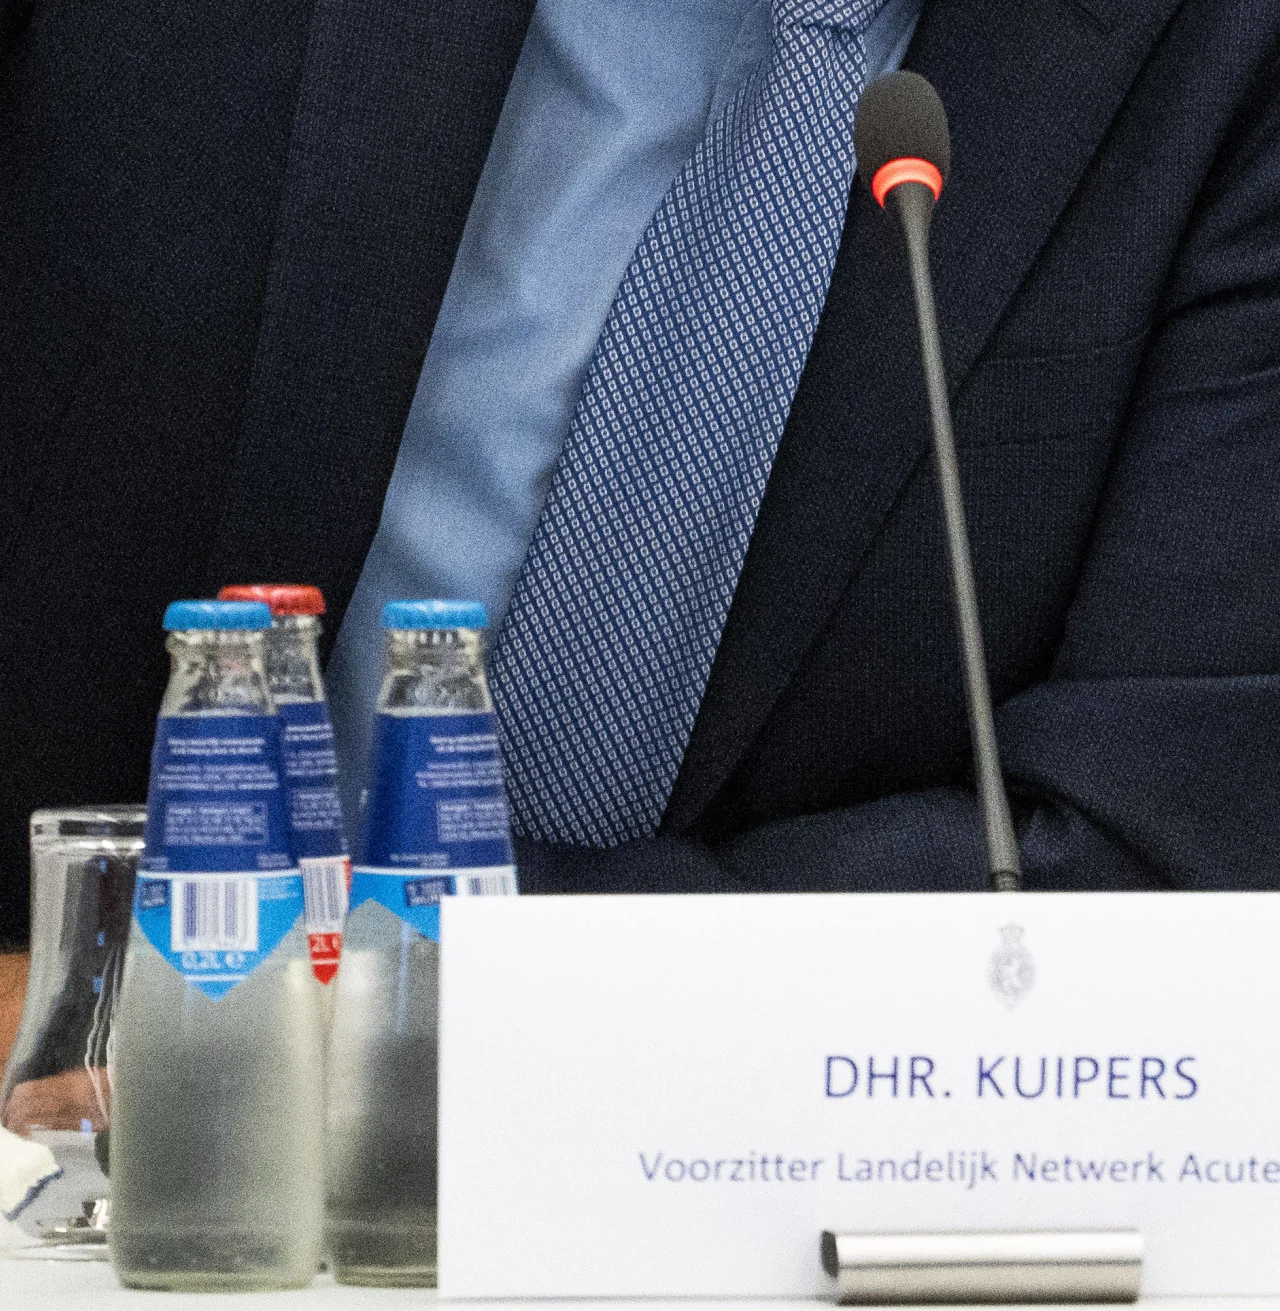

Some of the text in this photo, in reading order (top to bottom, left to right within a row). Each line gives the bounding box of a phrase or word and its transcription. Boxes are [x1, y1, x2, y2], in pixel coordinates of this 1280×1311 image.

[825, 1055, 1201, 1102] DHR. KUIPERS
[639, 1151, 824, 1184] Voorzitter
[838, 1151, 998, 1191] Landelijk
[1013, 1152, 1165, 1184] Netwerk
